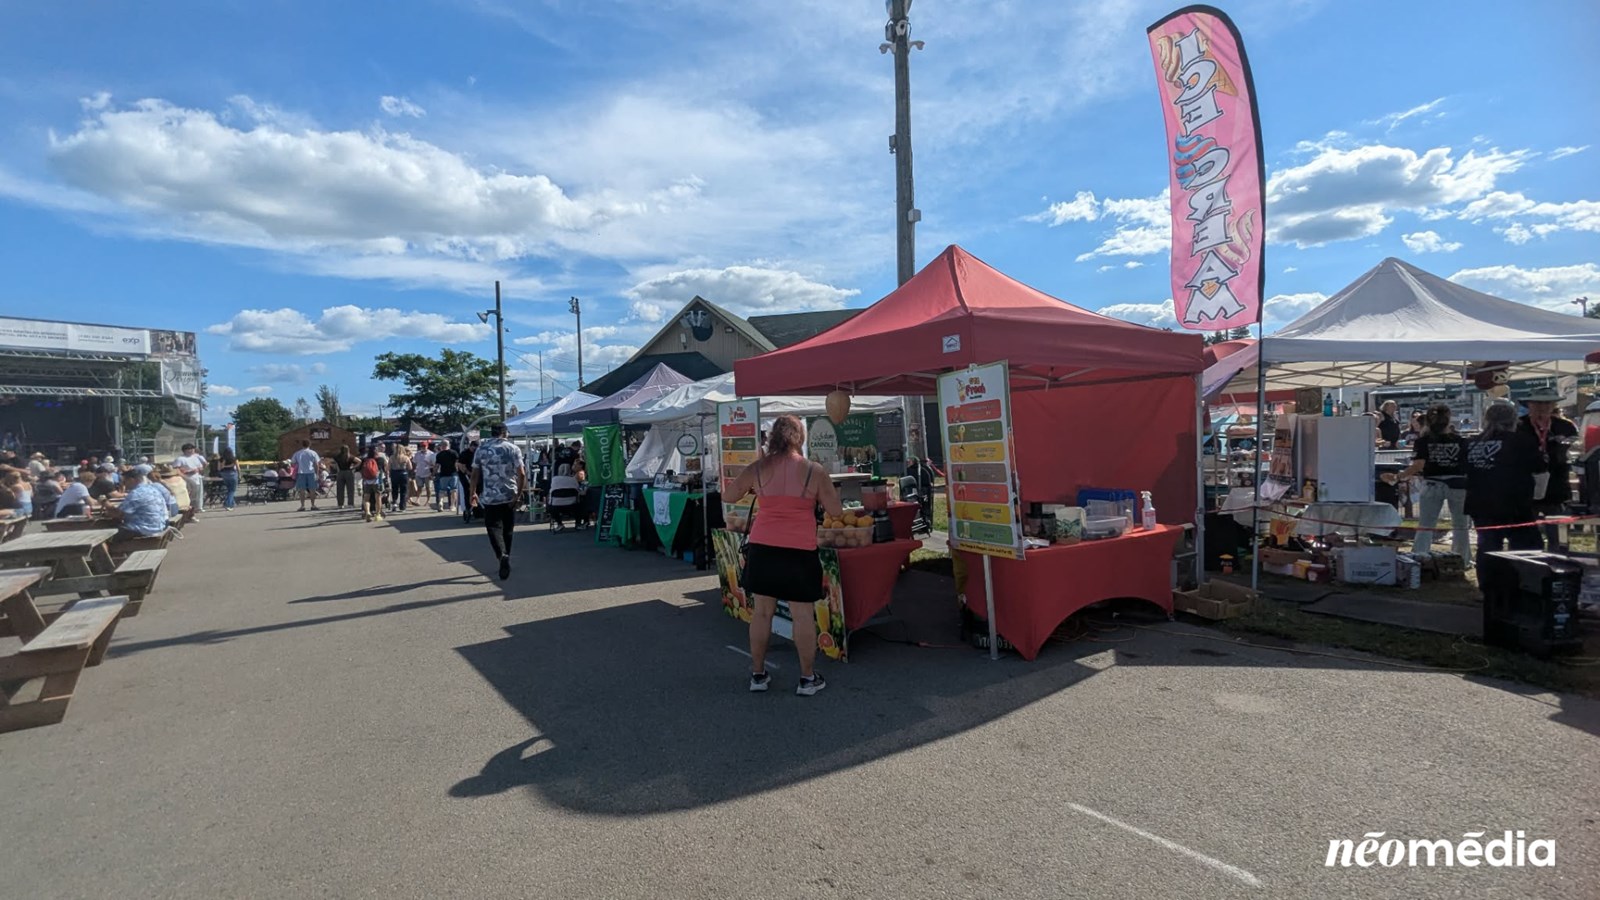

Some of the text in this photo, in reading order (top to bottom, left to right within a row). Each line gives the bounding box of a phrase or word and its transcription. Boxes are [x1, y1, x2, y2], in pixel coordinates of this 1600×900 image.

[122, 337, 140, 345] exp
[313, 431, 329, 439] BAR
[595, 429, 612, 480] Cannoli
